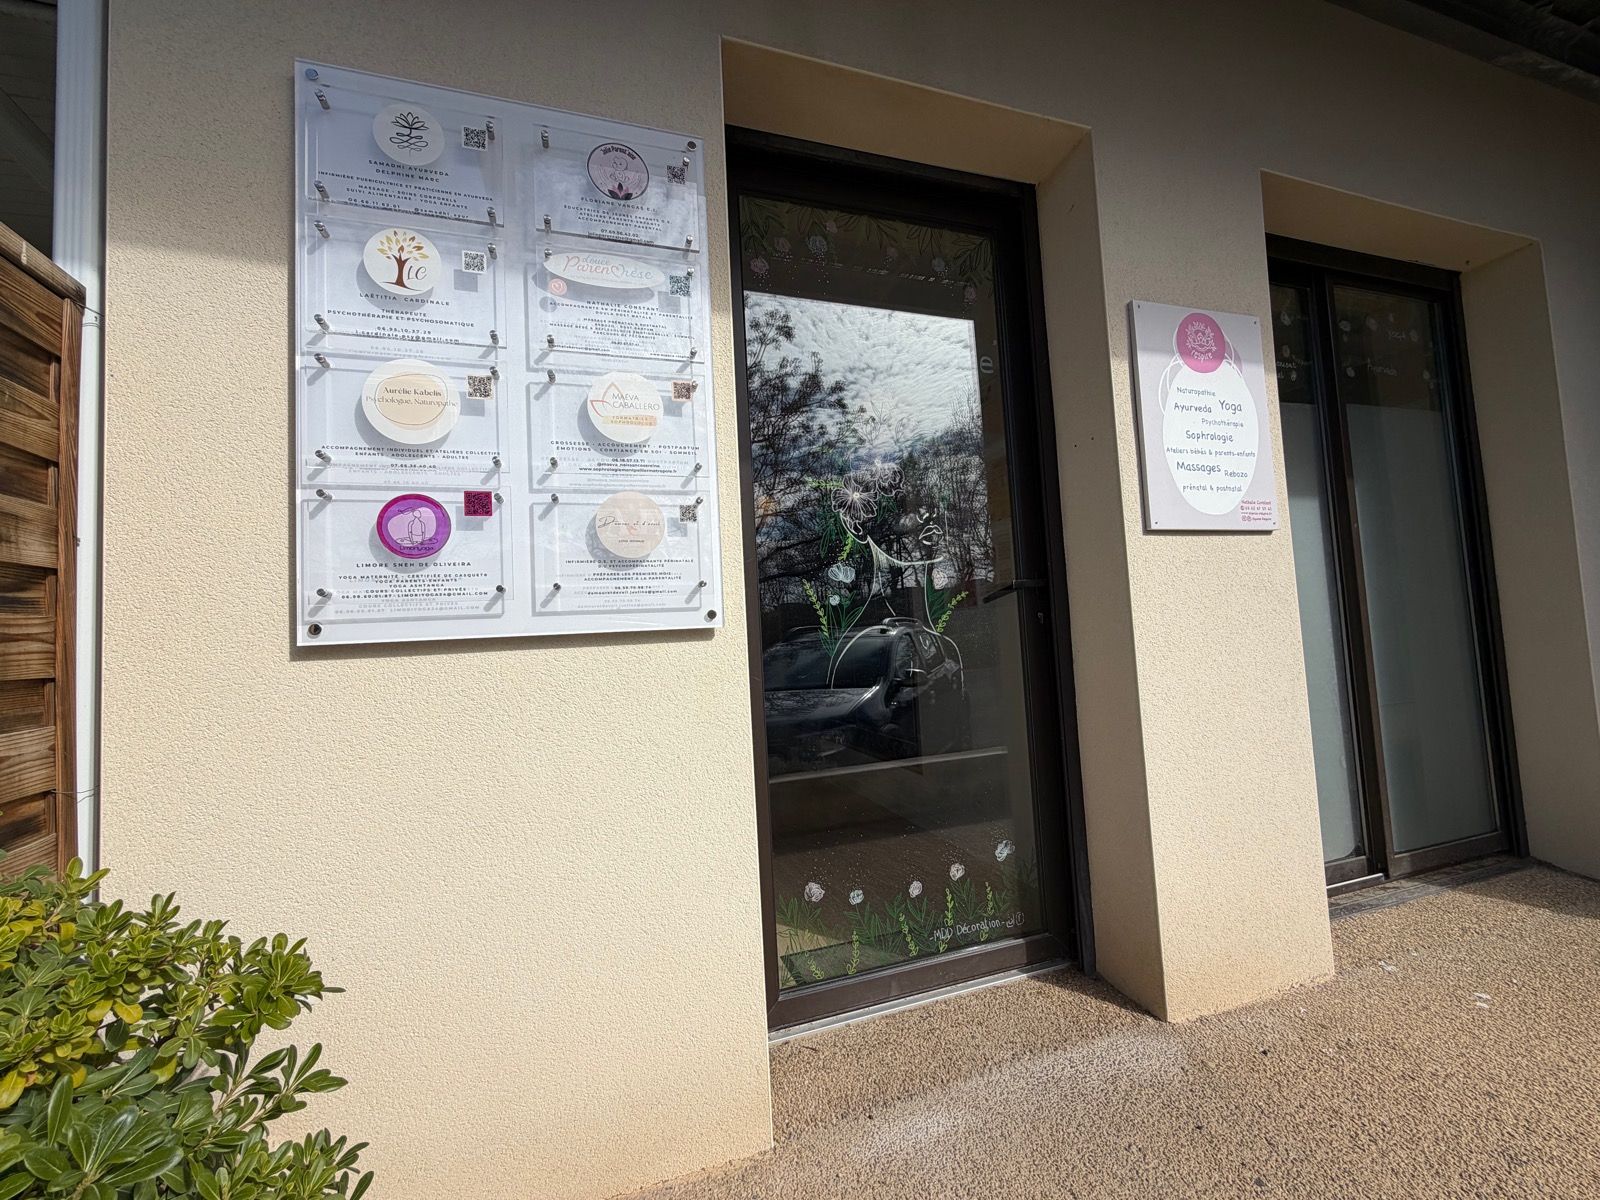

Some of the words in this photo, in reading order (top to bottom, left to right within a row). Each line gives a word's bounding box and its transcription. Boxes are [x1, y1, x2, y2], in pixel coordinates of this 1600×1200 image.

[368, 160, 405, 170] SAMADHI
[408, 166, 449, 176] AYURVEDA
[376, 168, 414, 179] DELPHINE
[358, 184, 389, 192] MASSAGE
[420, 194, 457, 203] CORPORELS
[414, 186, 452, 196] PRATICIENNE
[368, 191, 412, 200] ALIMENTAIRE
[440, 202, 468, 210] ENFANTS
[580, 196, 614, 206] FLORIANE
[404, 297, 450, 306] CARDINALE
[382, 308, 427, 317] THÉRAPEUTE
[328, 309, 393, 320] PSYCHOTHÉRAPIE
[406, 317, 474, 328] PSYCHOSOMATIQUE
[1190, 350, 1213, 362] respire
[383, 386, 412, 395] Aurélie
[1176, 386, 1216, 397] Naturopathie
[612, 400, 660, 411] CABALLERO
[1174, 402, 1212, 414] Ayurveda
[1218, 400, 1242, 414] Yoga
[1202, 418, 1244, 428] Psychothérapie
[1186, 430, 1234, 444] Sophrologie
[1214, 450, 1256, 458] parents-enfants
[1176, 460, 1222, 475] Massages
[1224, 470, 1248, 478] Rebozo
[1182, 484, 1208, 492] prénatal
